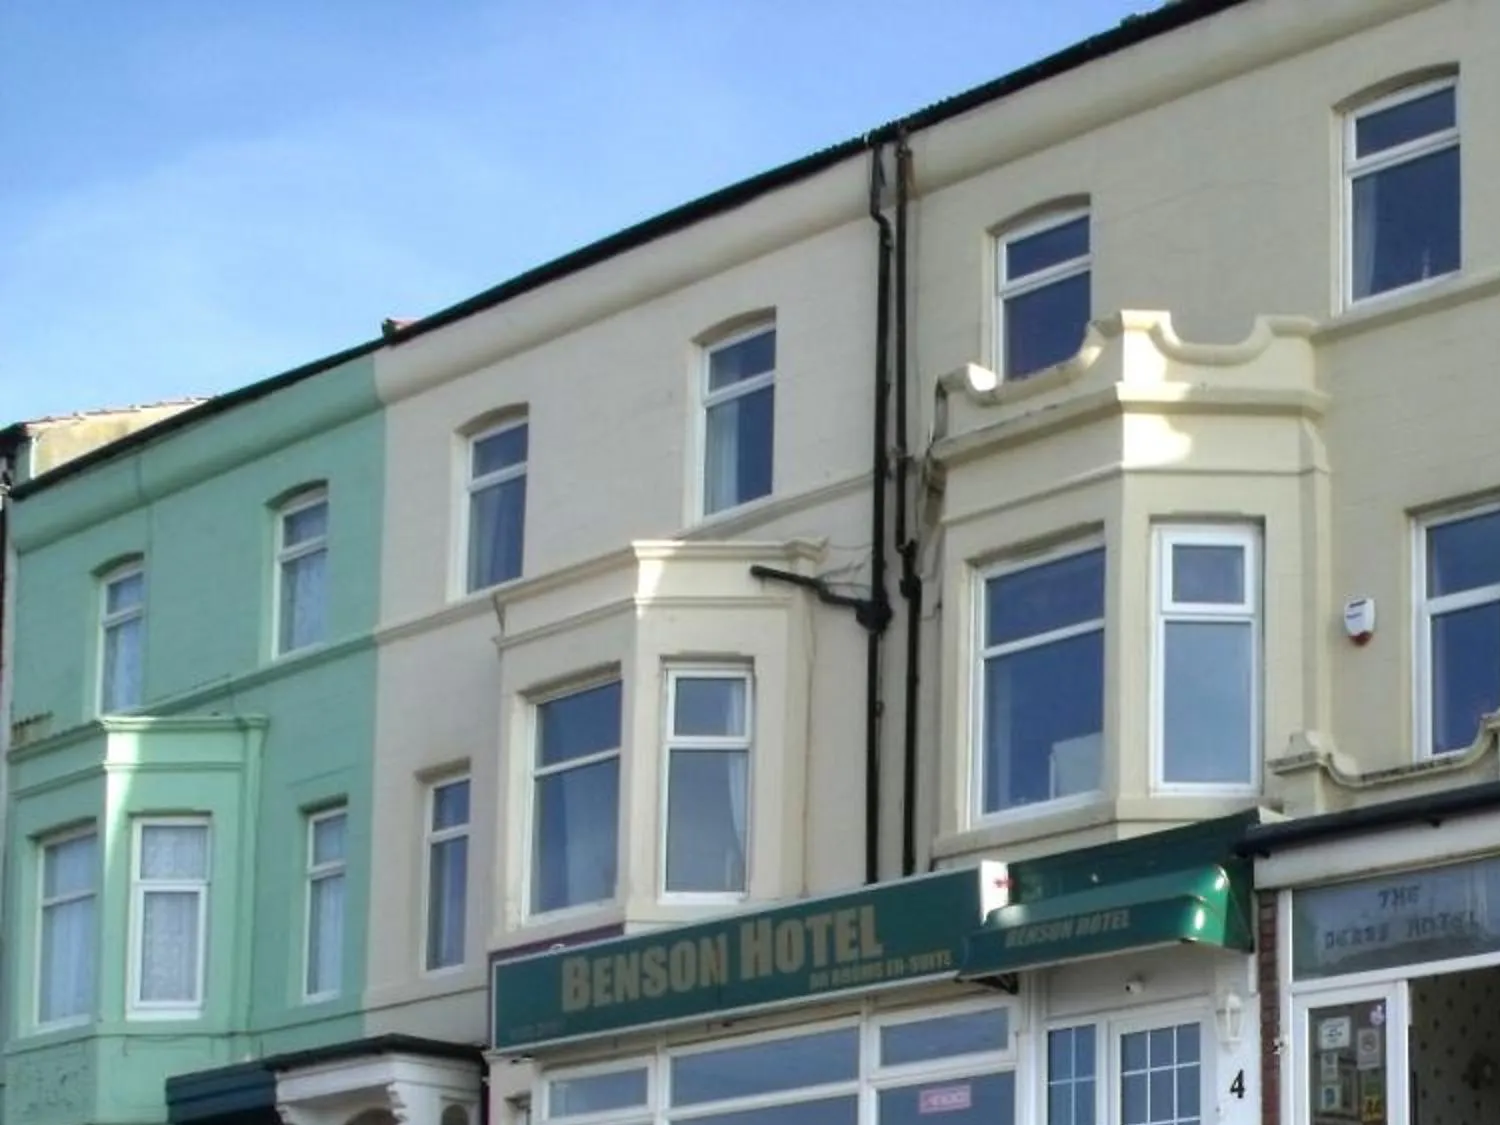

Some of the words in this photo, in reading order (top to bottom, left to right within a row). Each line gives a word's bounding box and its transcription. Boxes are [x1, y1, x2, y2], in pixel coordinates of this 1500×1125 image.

[561, 933, 728, 1012] BENSON
[741, 904, 882, 979] HOTEL
[1226, 1069, 1246, 1098] 4
